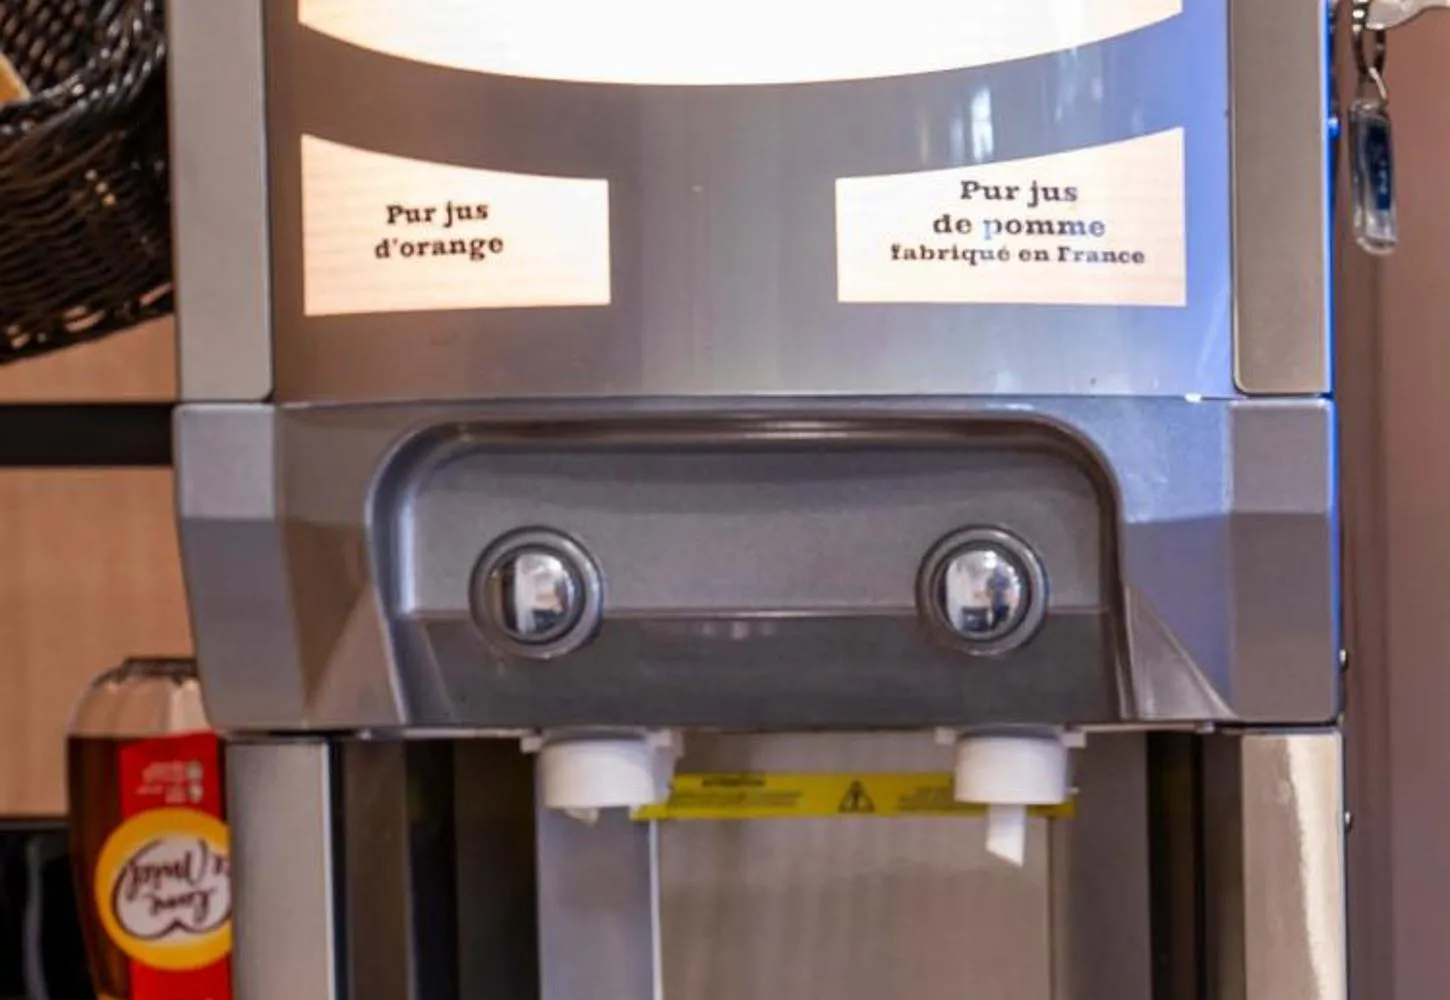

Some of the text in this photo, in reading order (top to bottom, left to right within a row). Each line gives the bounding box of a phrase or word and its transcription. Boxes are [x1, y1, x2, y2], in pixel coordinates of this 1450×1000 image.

[958, 179, 1078, 207] Pur jus
[386, 201, 489, 228] Pur jus
[932, 214, 1106, 241] de pomme
[374, 236, 504, 262] d'orange
[890, 243, 1146, 267] fabriqué en France
